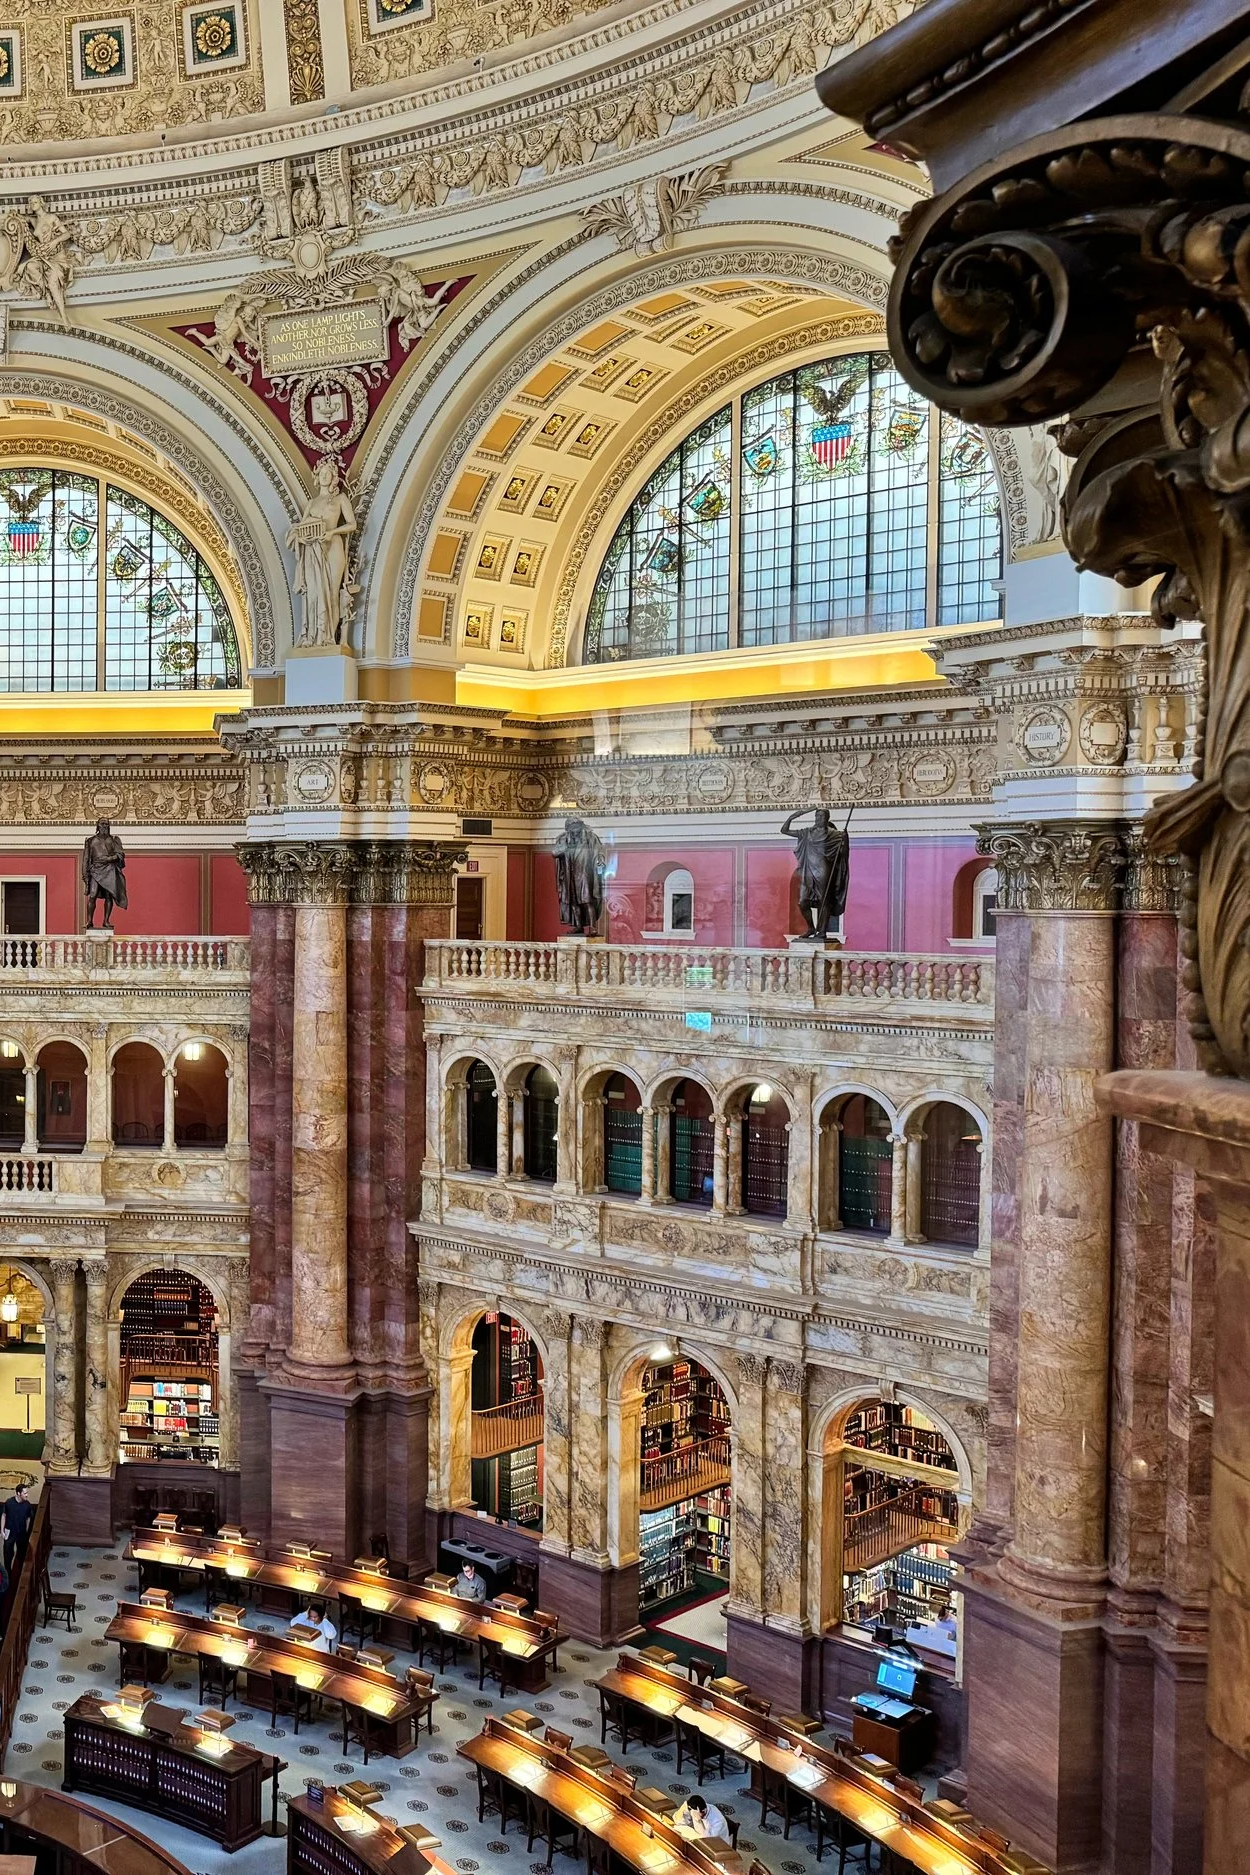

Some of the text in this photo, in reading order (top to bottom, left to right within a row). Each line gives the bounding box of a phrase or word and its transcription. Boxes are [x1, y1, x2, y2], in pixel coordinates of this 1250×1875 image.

[280, 309, 366, 333] AS ONE LAMP LIGHTS
[329, 321, 358, 335] GROWS
[292, 332, 356, 351] SO NOBLENESS
[272, 347, 325, 365] ENKINDLETH
[1029, 731, 1055, 742] HISTORY
[307, 778, 319, 786] ART
